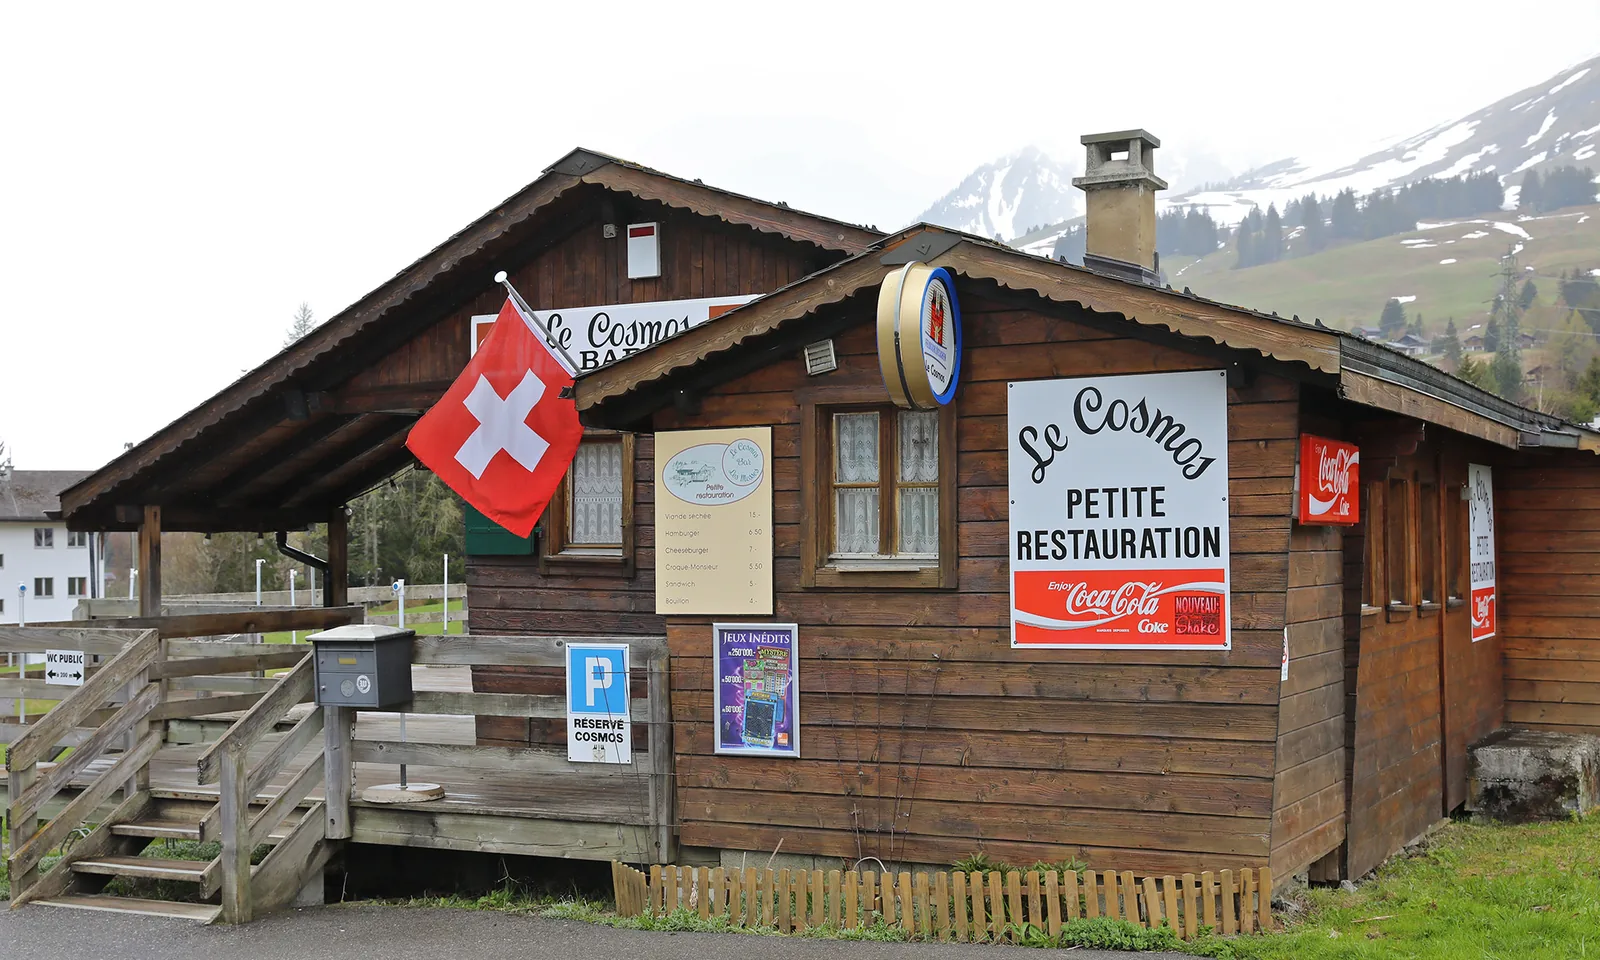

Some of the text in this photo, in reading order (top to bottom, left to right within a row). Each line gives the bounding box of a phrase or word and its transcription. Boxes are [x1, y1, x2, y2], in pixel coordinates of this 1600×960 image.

[547, 313, 572, 350] Le
[1018, 386, 1217, 484] Le Cosmos
[695, 491, 734, 499] restauration
[1067, 486, 1166, 519] PETITE
[664, 530, 700, 539] Hamburger
[748, 528, 763, 536] 6.50
[1017, 526, 1221, 560] RESTAURATION
[664, 547, 709, 555] Cheeseburger
[665, 563, 719, 572] Croque-Monsieur
[665, 580, 696, 588] Sandwich
[1048, 582, 1074, 591] Enjoy
[1066, 582, 1163, 616] Coca-Cola
[1138, 618, 1169, 634] Coke
[1176, 615, 1219, 635] Shake
[723, 631, 790, 645] JEUX INÉDITS
[47, 653, 83, 664] WC PUBLIC
[585, 656, 613, 707] P
[574, 717, 625, 730] RÉSERVÉ
[574, 731, 624, 744] COSMOS
